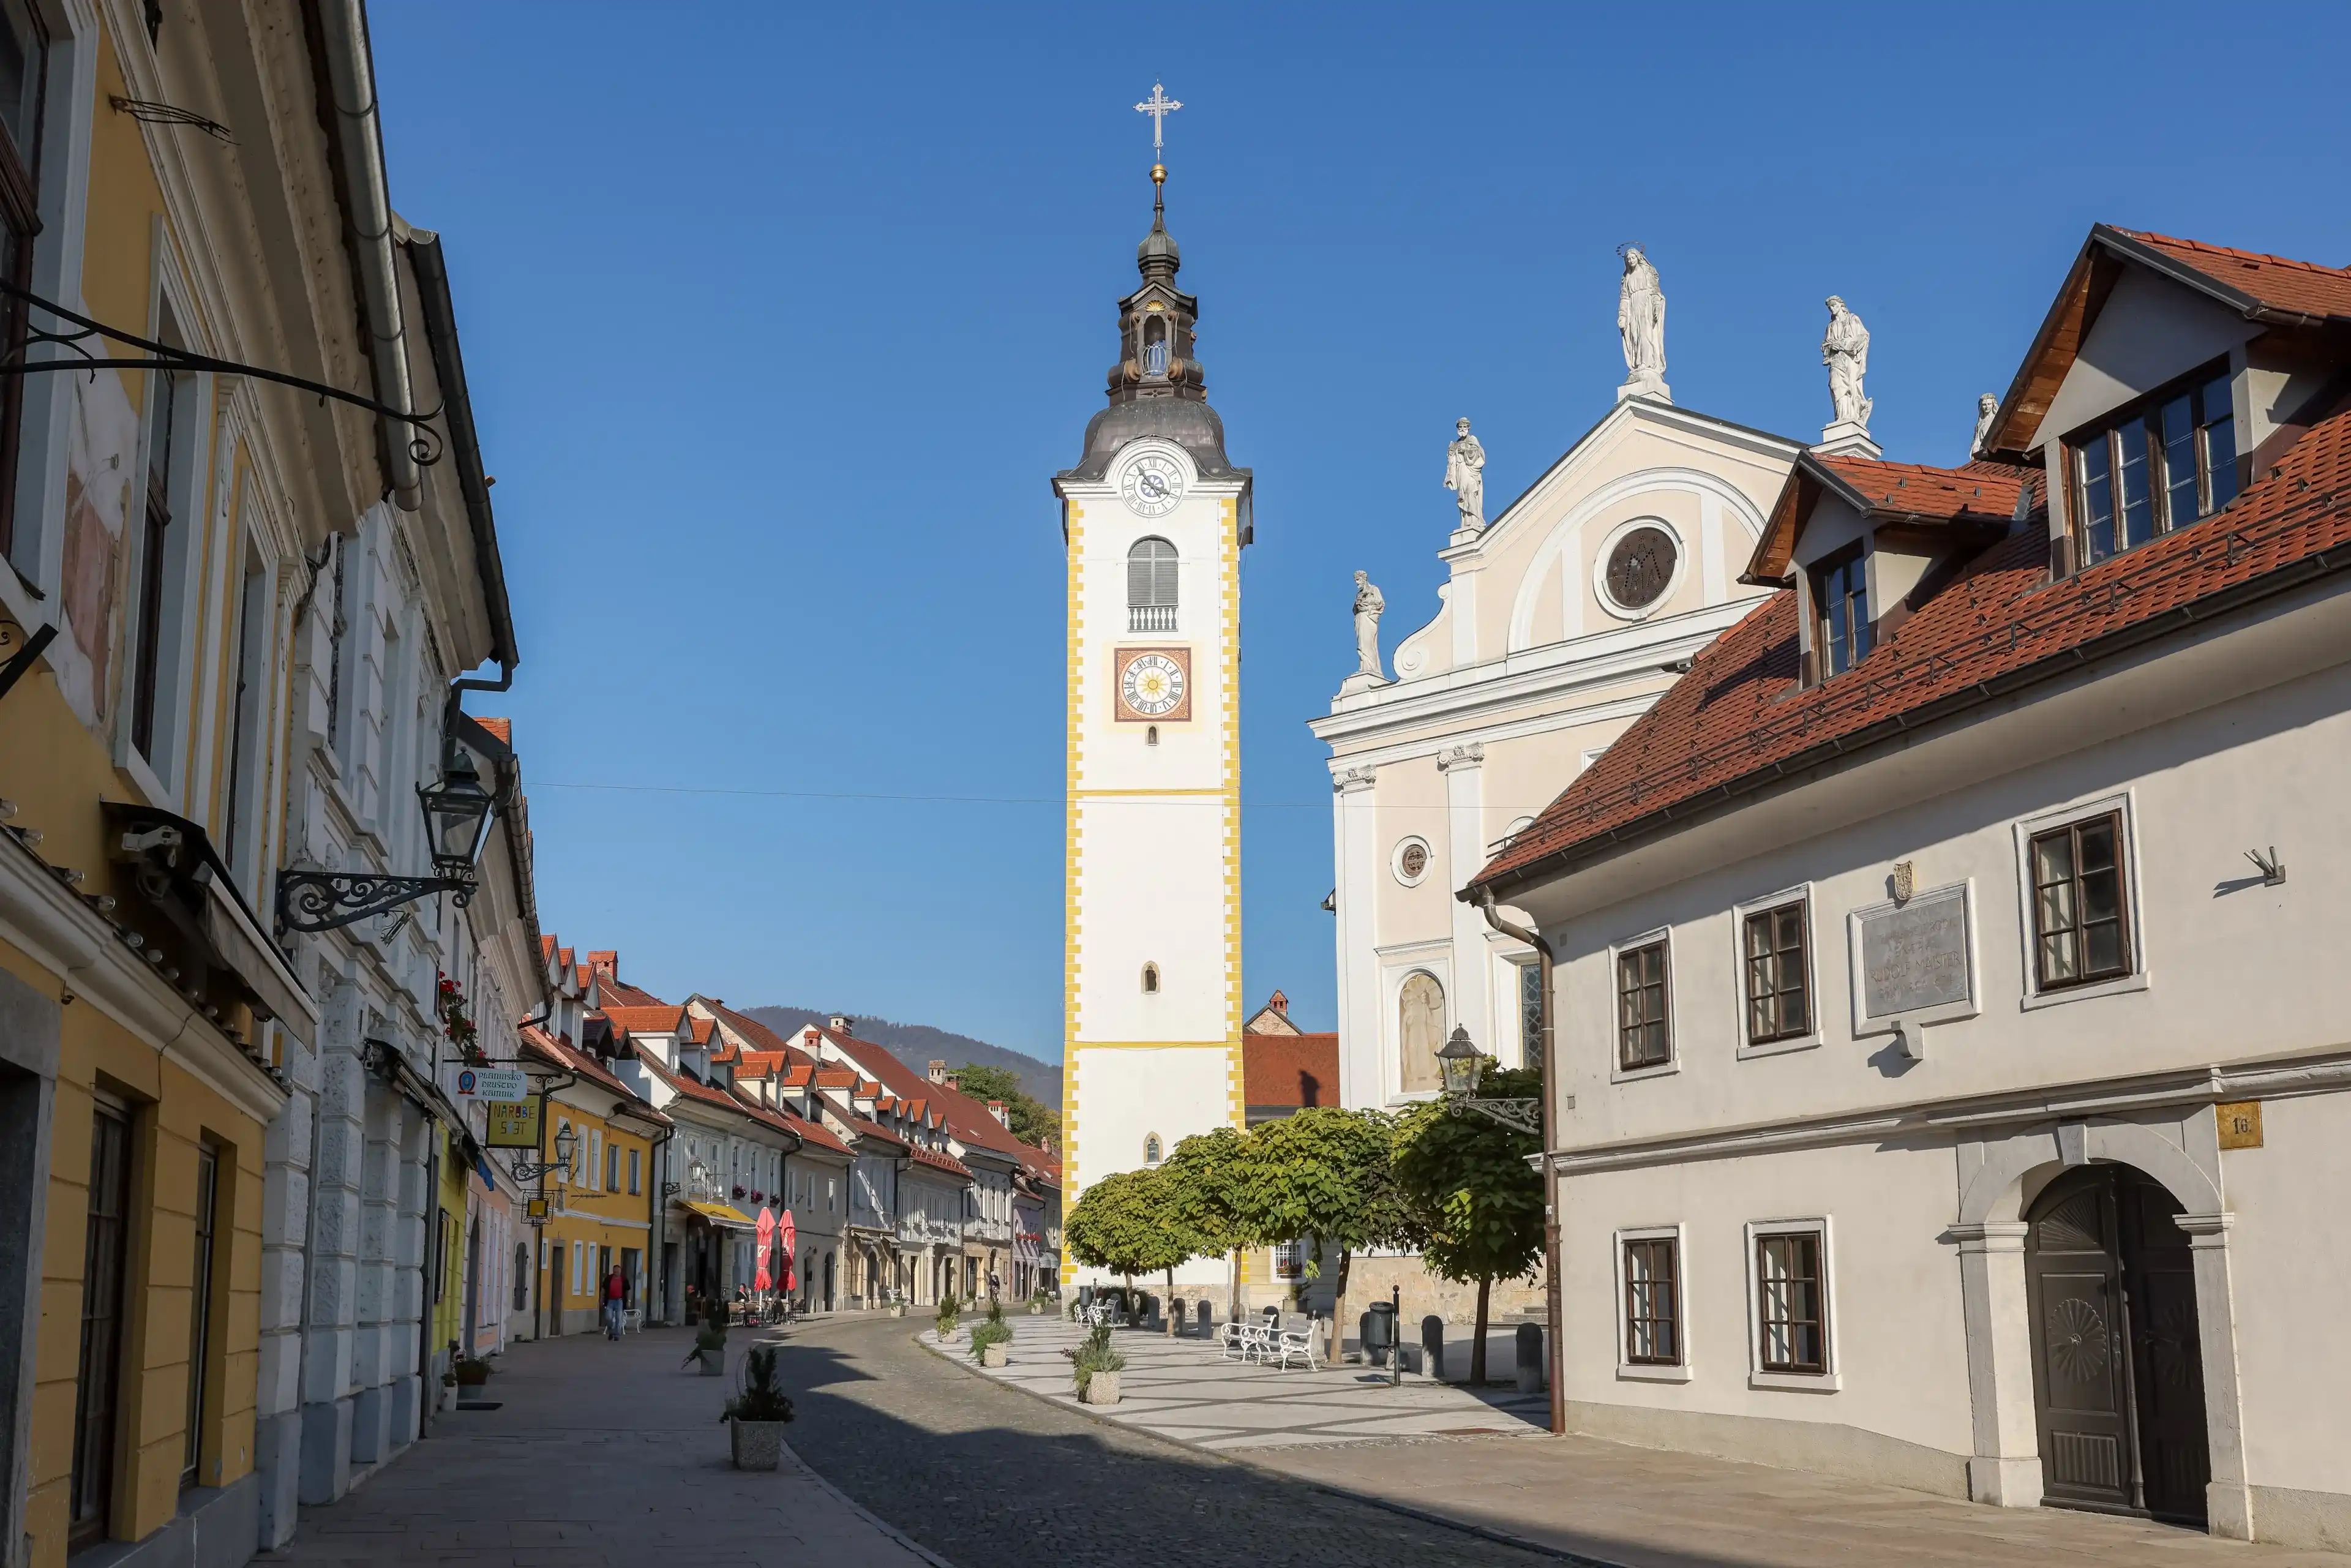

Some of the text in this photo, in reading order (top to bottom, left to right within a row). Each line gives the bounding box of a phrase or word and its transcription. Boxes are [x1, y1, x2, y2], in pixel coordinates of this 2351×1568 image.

[1148, 459, 1157, 468] XII
[1870, 961, 1911, 983] RUDOLF
[1915, 950, 1962, 972] MAISTER
[478, 1072, 522, 1081] PLANINSKO
[481, 1080, 517, 1089] DRUŠTVO
